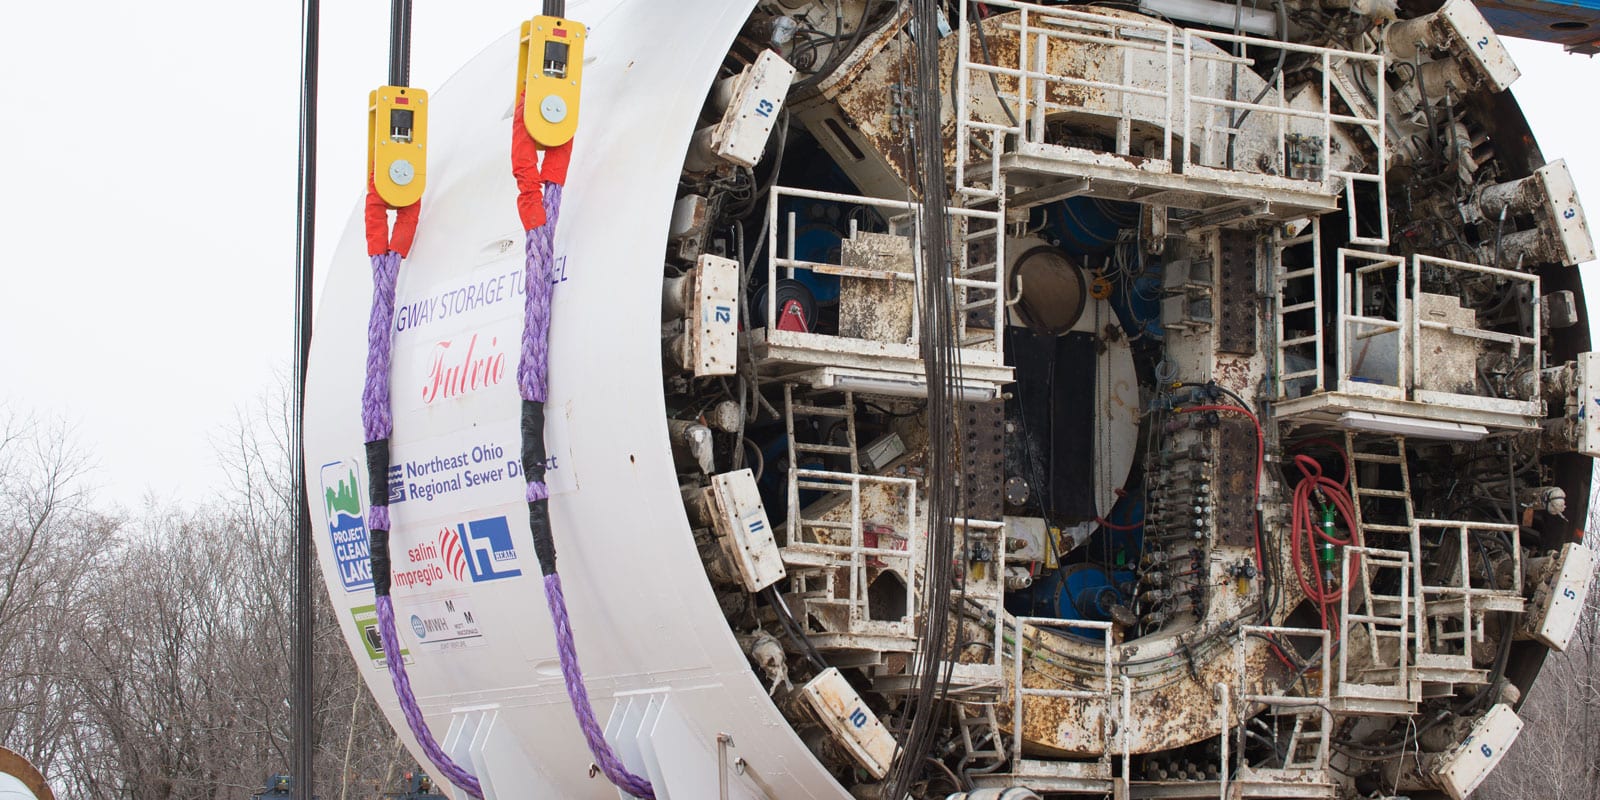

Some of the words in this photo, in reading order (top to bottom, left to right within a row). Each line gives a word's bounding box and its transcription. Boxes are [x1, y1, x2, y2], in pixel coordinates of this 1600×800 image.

[1477, 36, 1489, 50] 2
[755, 99, 773, 117] 13
[396, 296, 438, 332] GWAY
[439, 275, 506, 319] STORAGE
[510, 256, 567, 297] TUEL
[716, 306, 730, 324] 12
[422, 333, 504, 404] Fulvio
[406, 451, 469, 479] Northeast
[472, 443, 503, 463] Ohio
[409, 473, 461, 501] Regional
[464, 468, 503, 487] Sewer
[507, 455, 558, 478] Dict
[333, 527, 364, 544] PROJECT
[749, 520, 764, 533] 11
[336, 540, 370, 562] CLEAN
[408, 541, 437, 562] salini
[340, 559, 373, 583] LAKE
[393, 563, 443, 589] impregilo
[1563, 587, 1575, 600] 5
[424, 617, 449, 632] MWH
[849, 707, 867, 728] 10
[1481, 743, 1492, 757] 6
